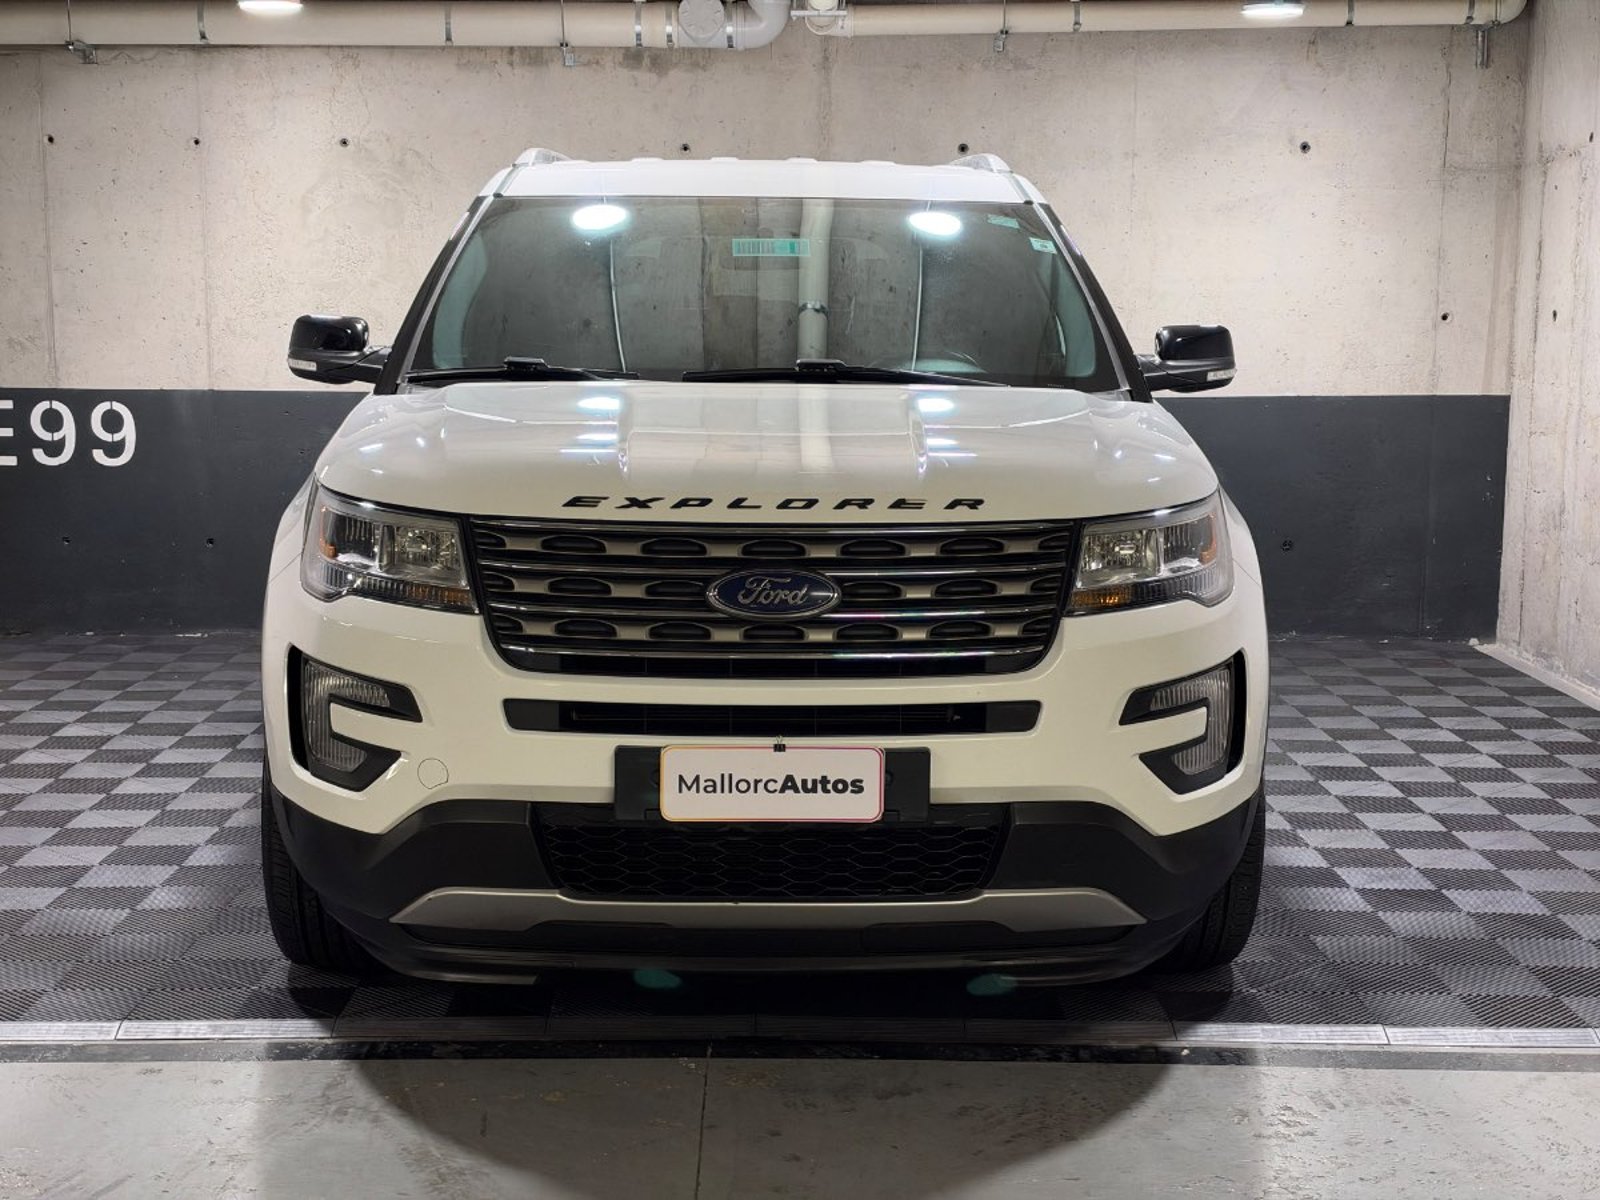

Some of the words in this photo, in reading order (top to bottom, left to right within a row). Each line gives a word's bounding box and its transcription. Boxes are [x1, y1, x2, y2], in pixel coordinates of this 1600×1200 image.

[562, 495, 985, 510] EXPLORER
[737, 576, 808, 605] Ford
[678, 773, 865, 795] MallorcAutos
